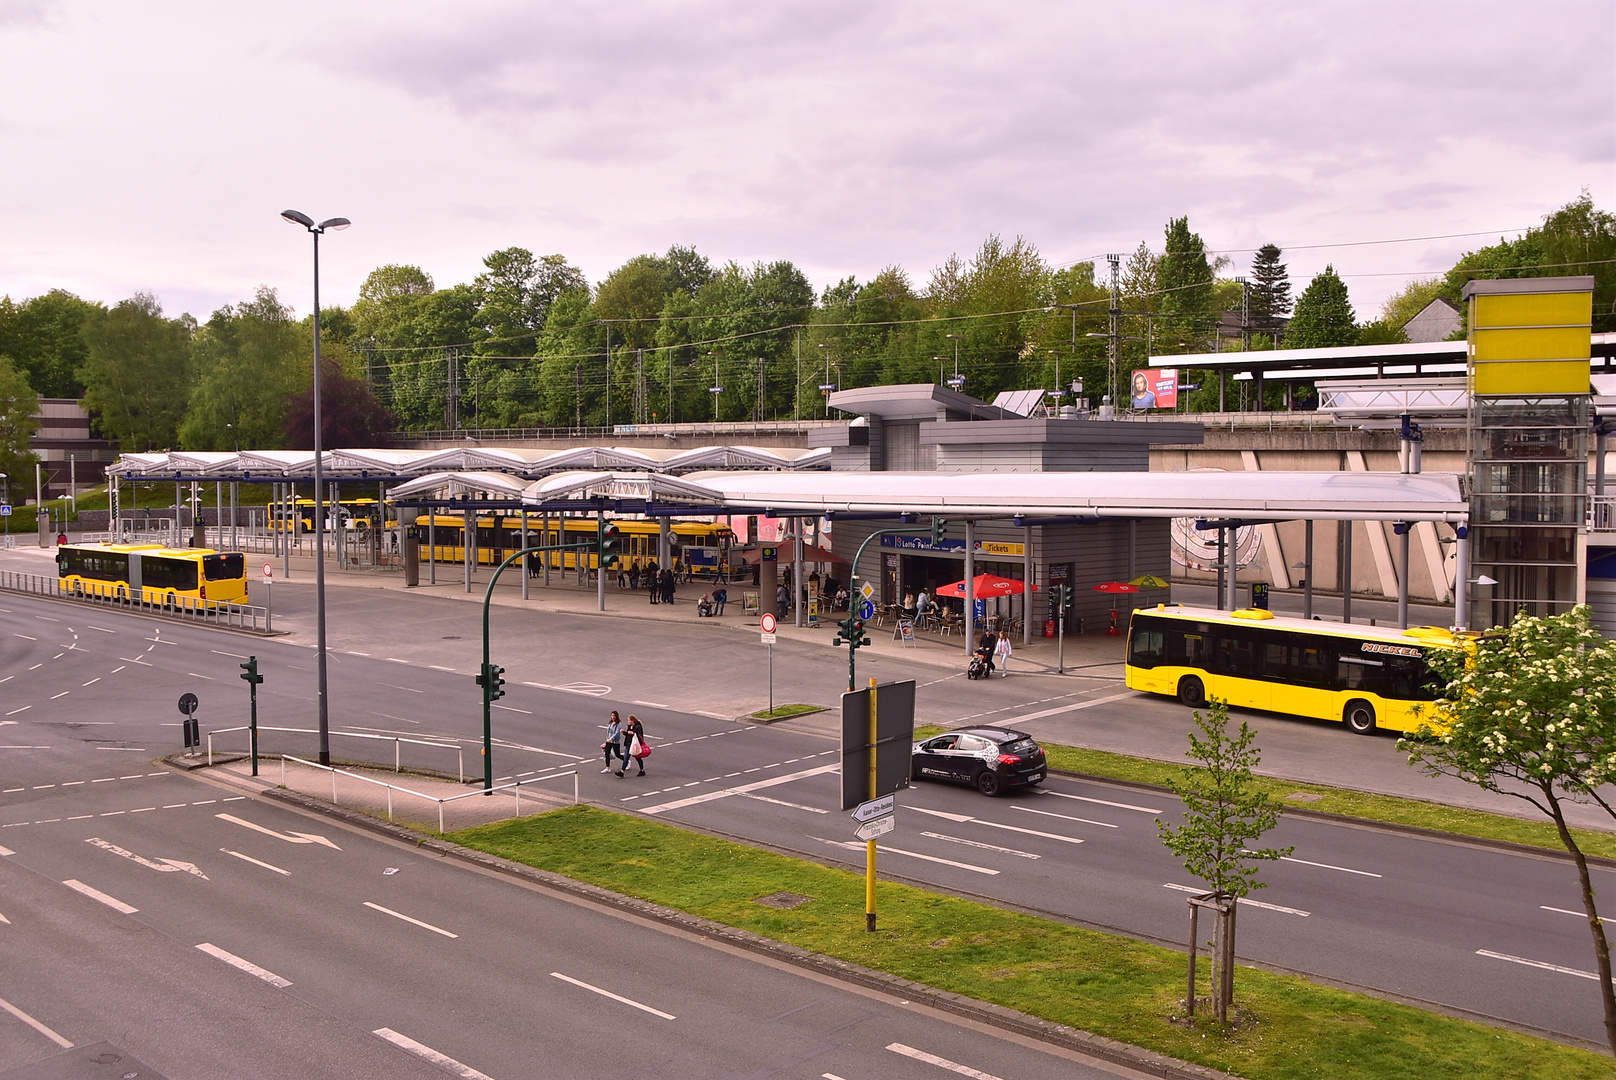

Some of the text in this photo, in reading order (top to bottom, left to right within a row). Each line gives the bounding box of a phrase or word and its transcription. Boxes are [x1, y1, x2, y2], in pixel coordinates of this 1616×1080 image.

[988, 544, 1009, 553] Tickets
[1262, 584, 1268, 593] 12
[1361, 642, 1422, 659] NICKEL
